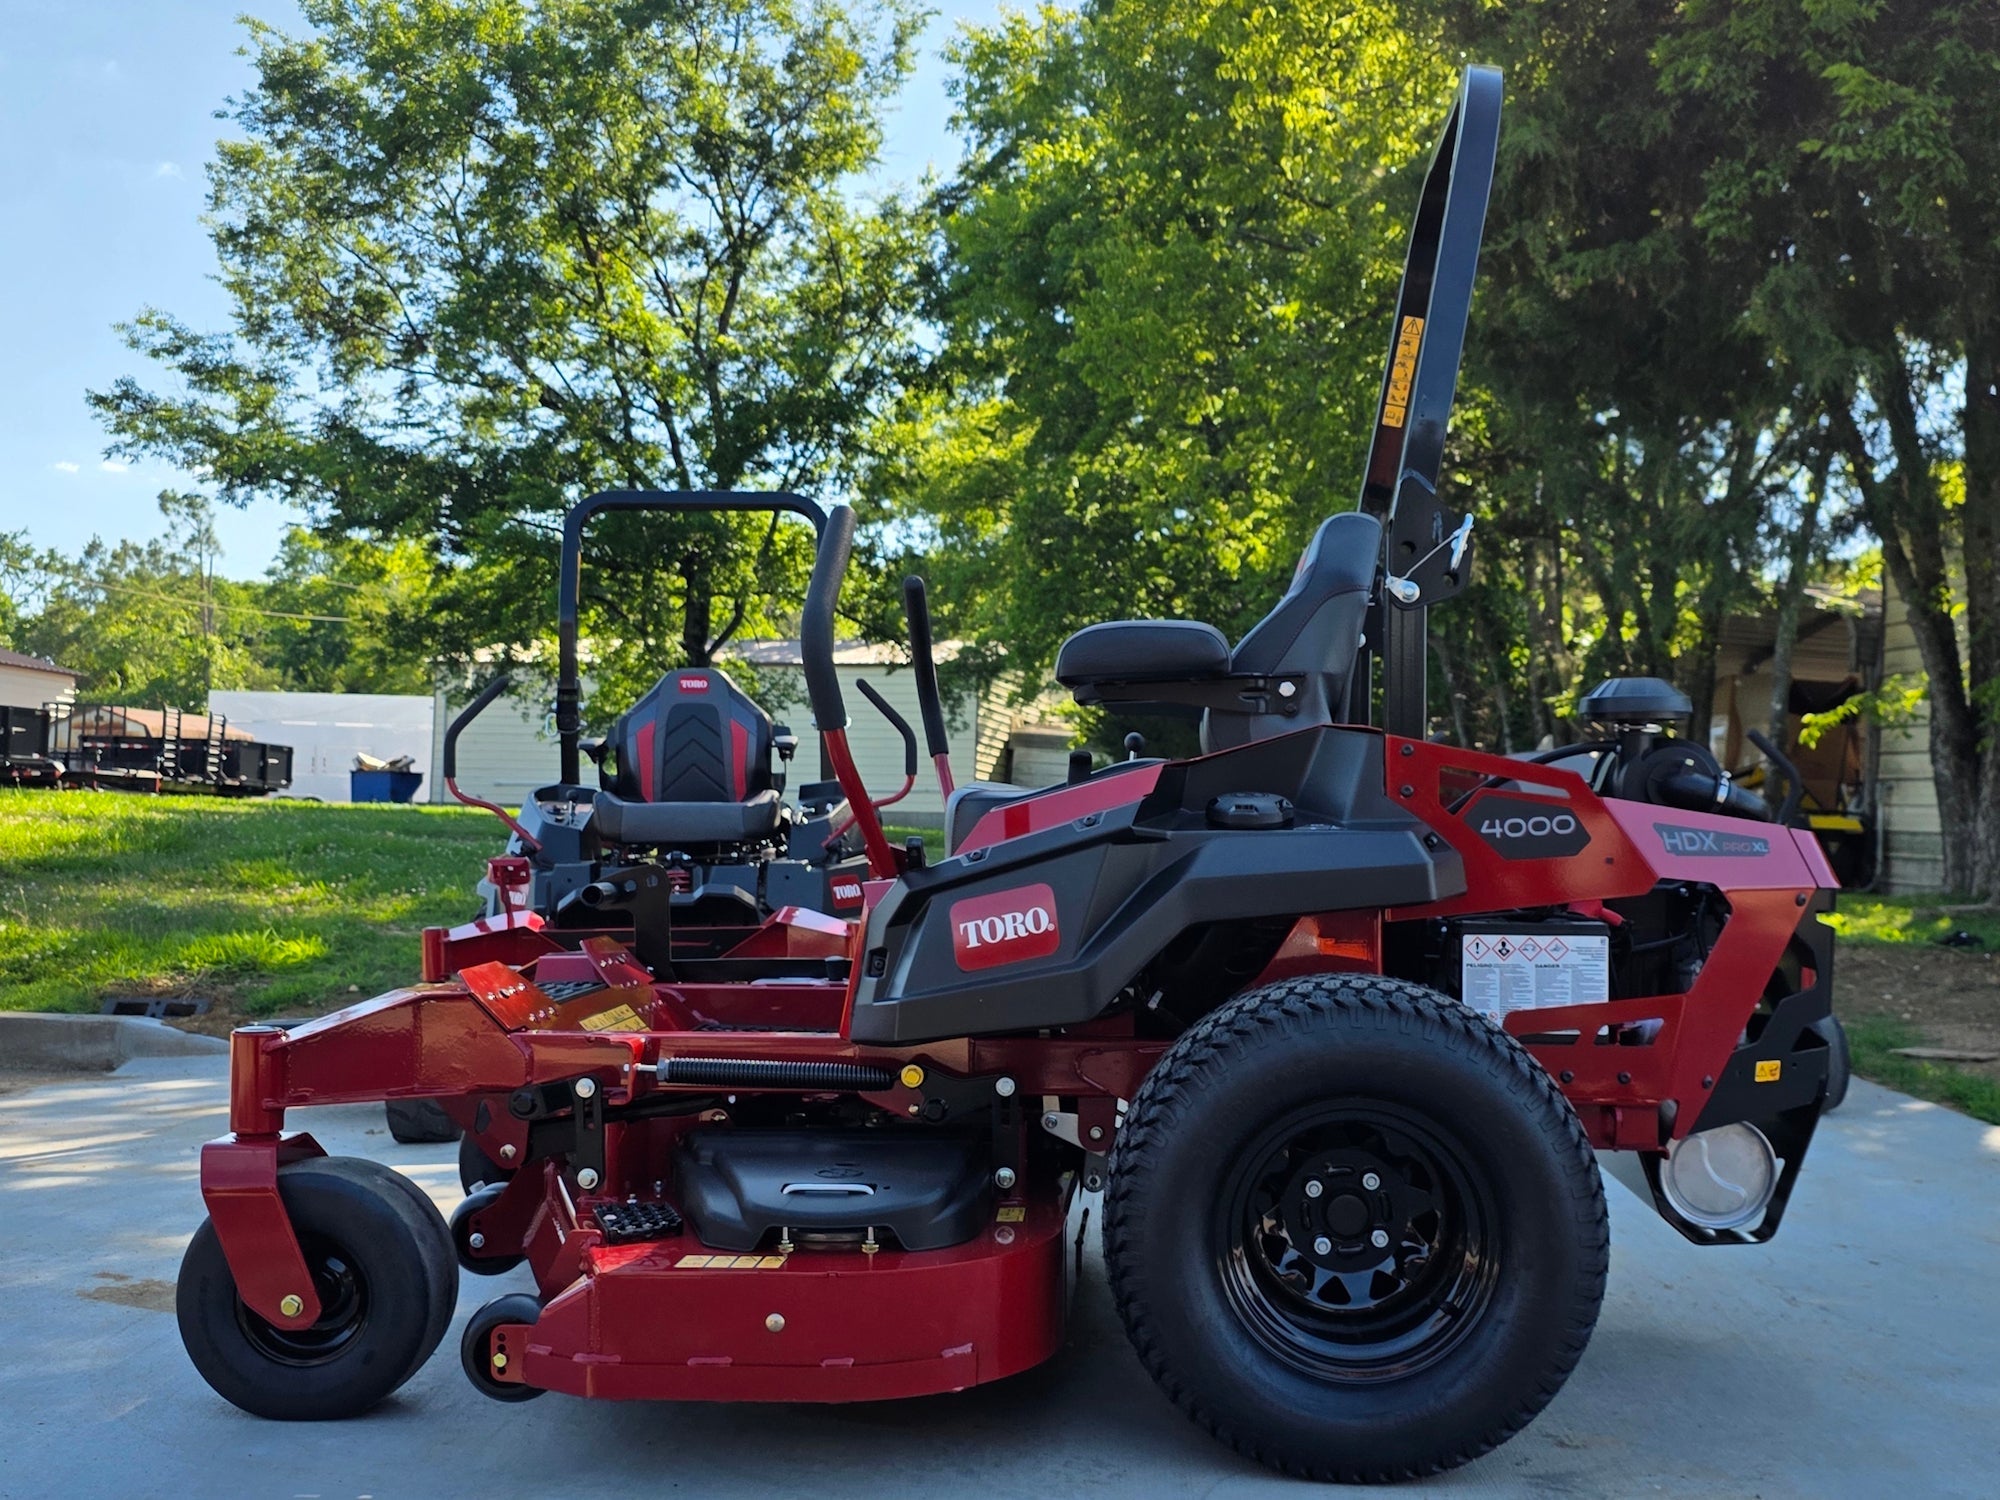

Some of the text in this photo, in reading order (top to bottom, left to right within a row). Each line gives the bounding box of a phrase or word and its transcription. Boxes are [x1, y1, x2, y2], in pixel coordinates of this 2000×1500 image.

[680, 679, 708, 689] TORO
[1480, 814, 1576, 838] 4000
[1662, 831, 1769, 853] HDX PRO XL
[833, 883, 862, 900] TORO
